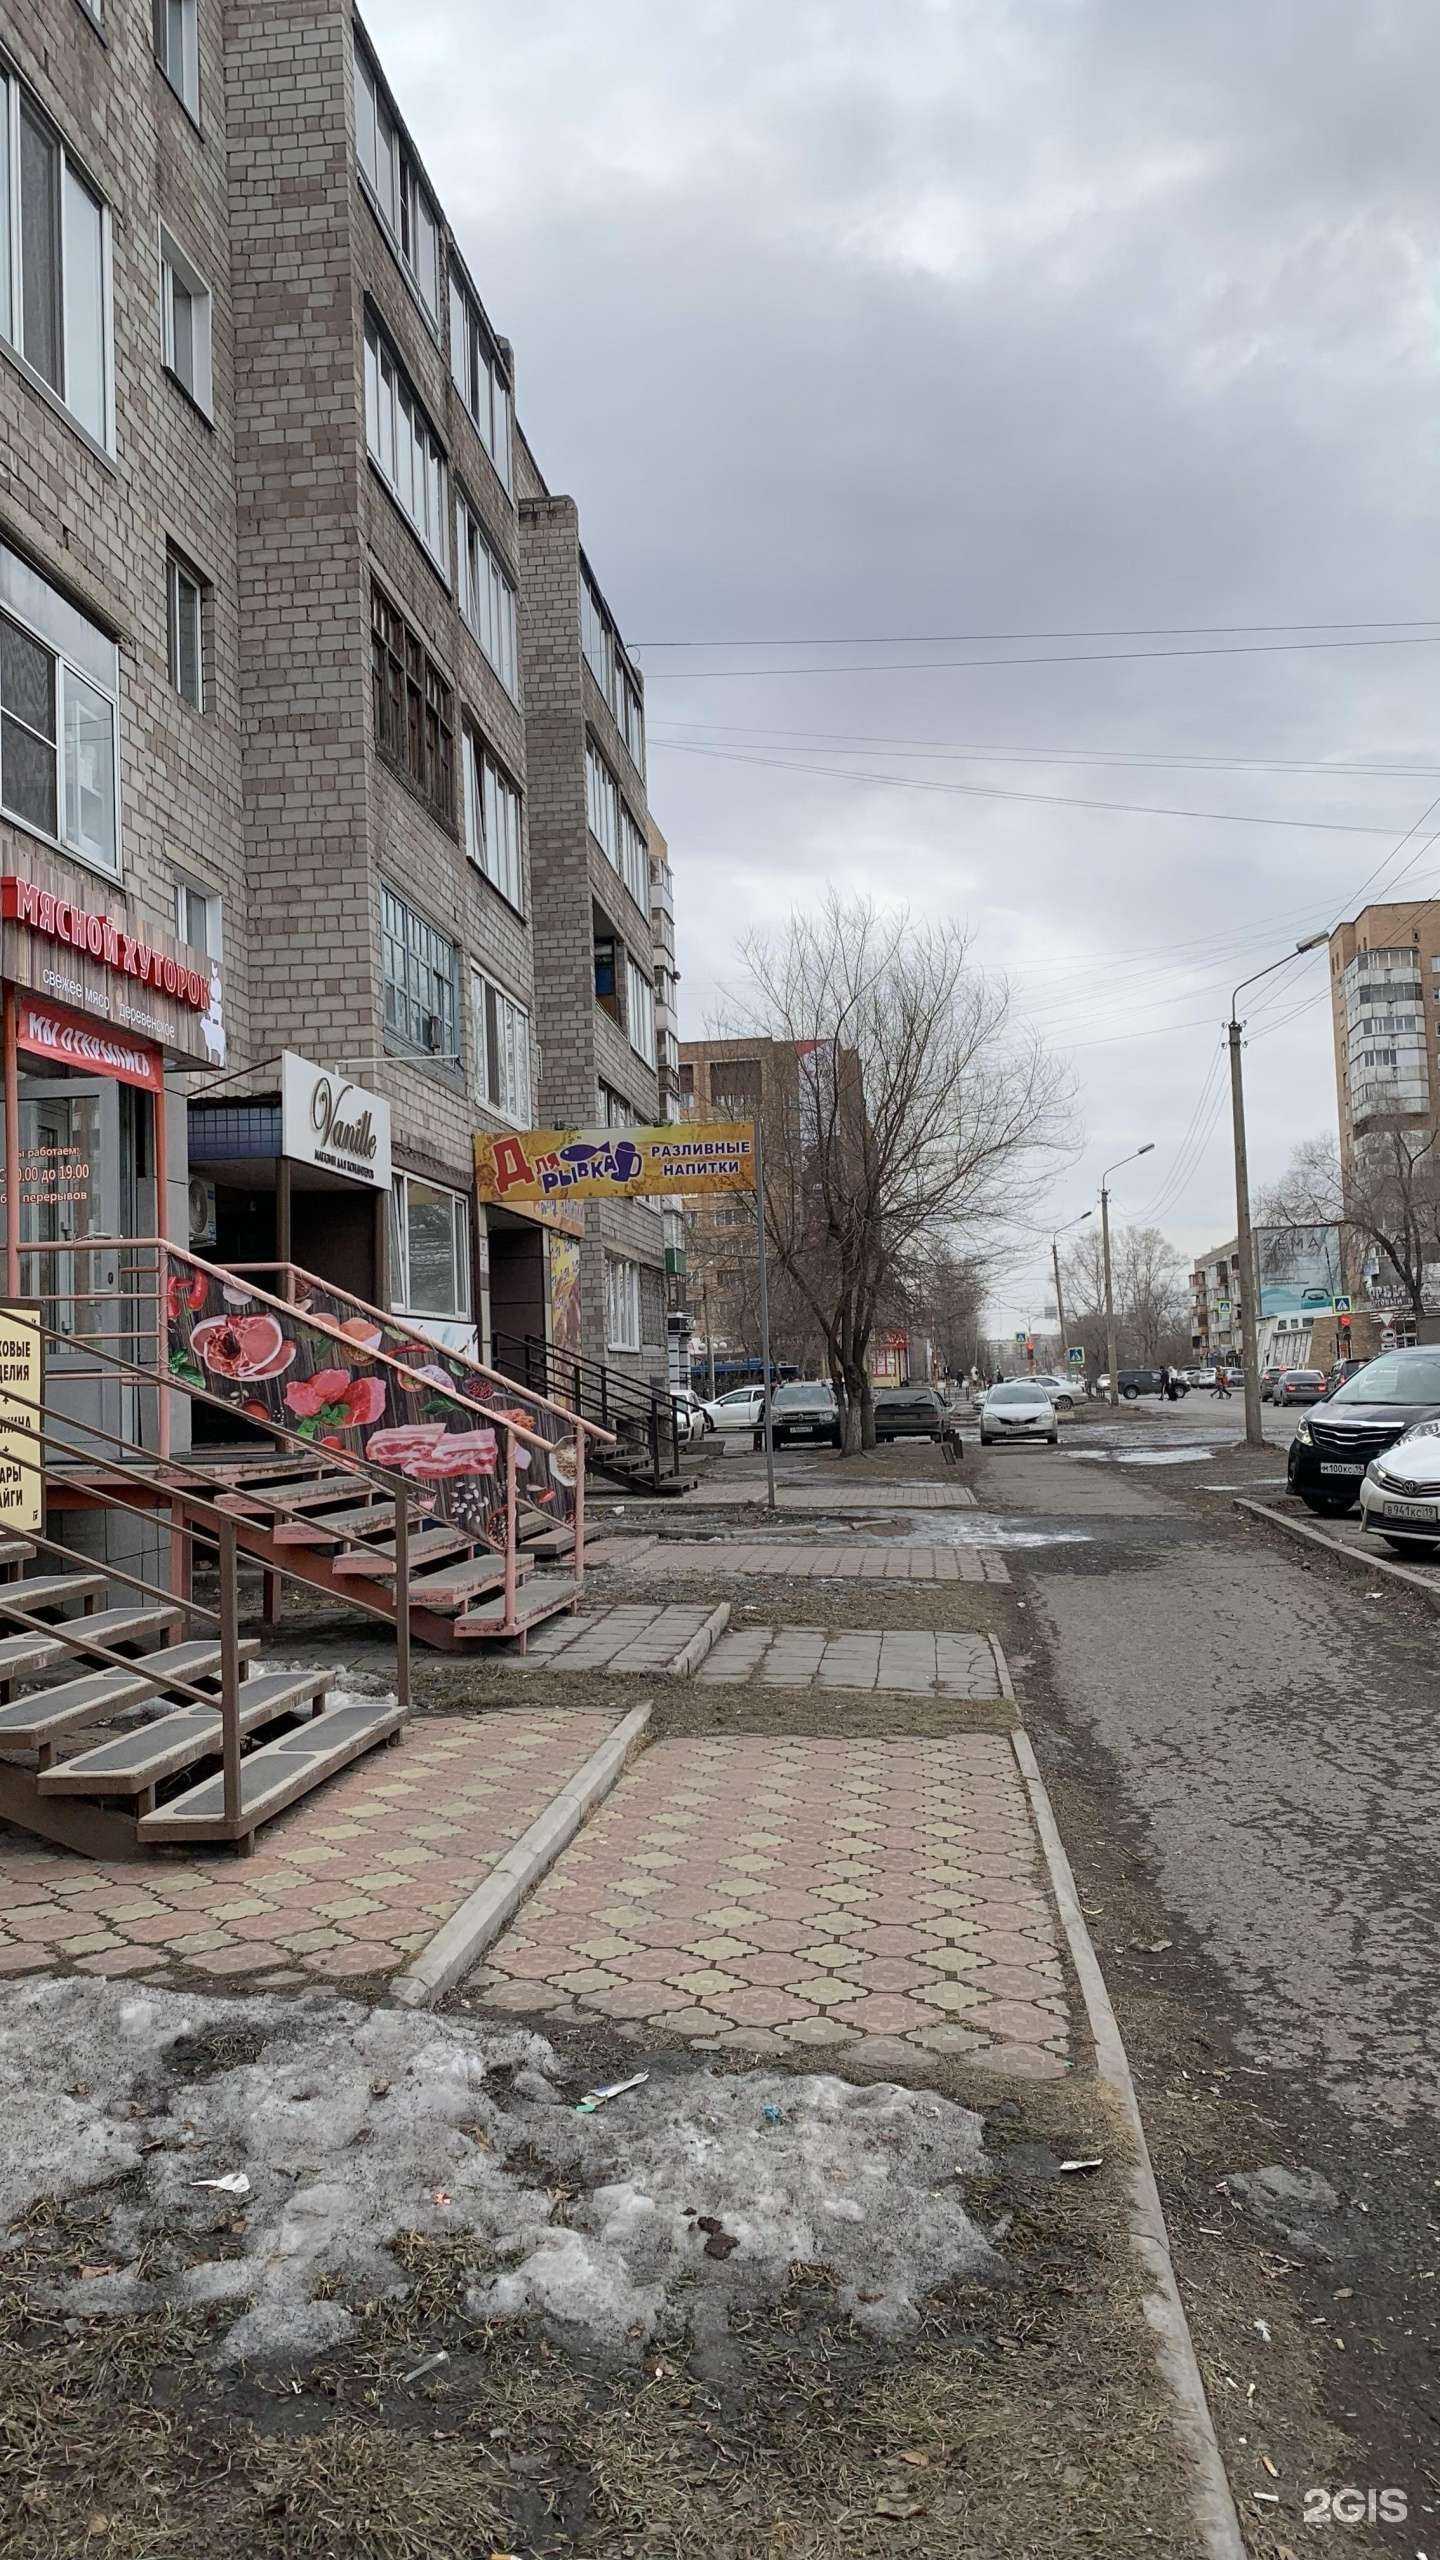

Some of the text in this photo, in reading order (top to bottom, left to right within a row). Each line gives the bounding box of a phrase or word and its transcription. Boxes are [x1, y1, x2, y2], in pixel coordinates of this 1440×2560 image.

[16, 877, 211, 1011] МЯСНОЙ ХУТОРОК
[42, 968, 176, 1039] свежее мясо деревенское
[28, 1011, 151, 1077] МЫ ОТКРЫЛИСЬ
[313, 1077, 377, 1159] Vanille
[27, 1146, 81, 1159] работаем:
[651, 1141, 751, 1157] РАЗЛИВНЫЕ
[42, 1169, 56, 1184] до
[59, 1164, 90, 1180] 19.00
[663, 1161, 739, 1176] НАПИТКИ
[23, 1191, 88, 1205] перерывов
